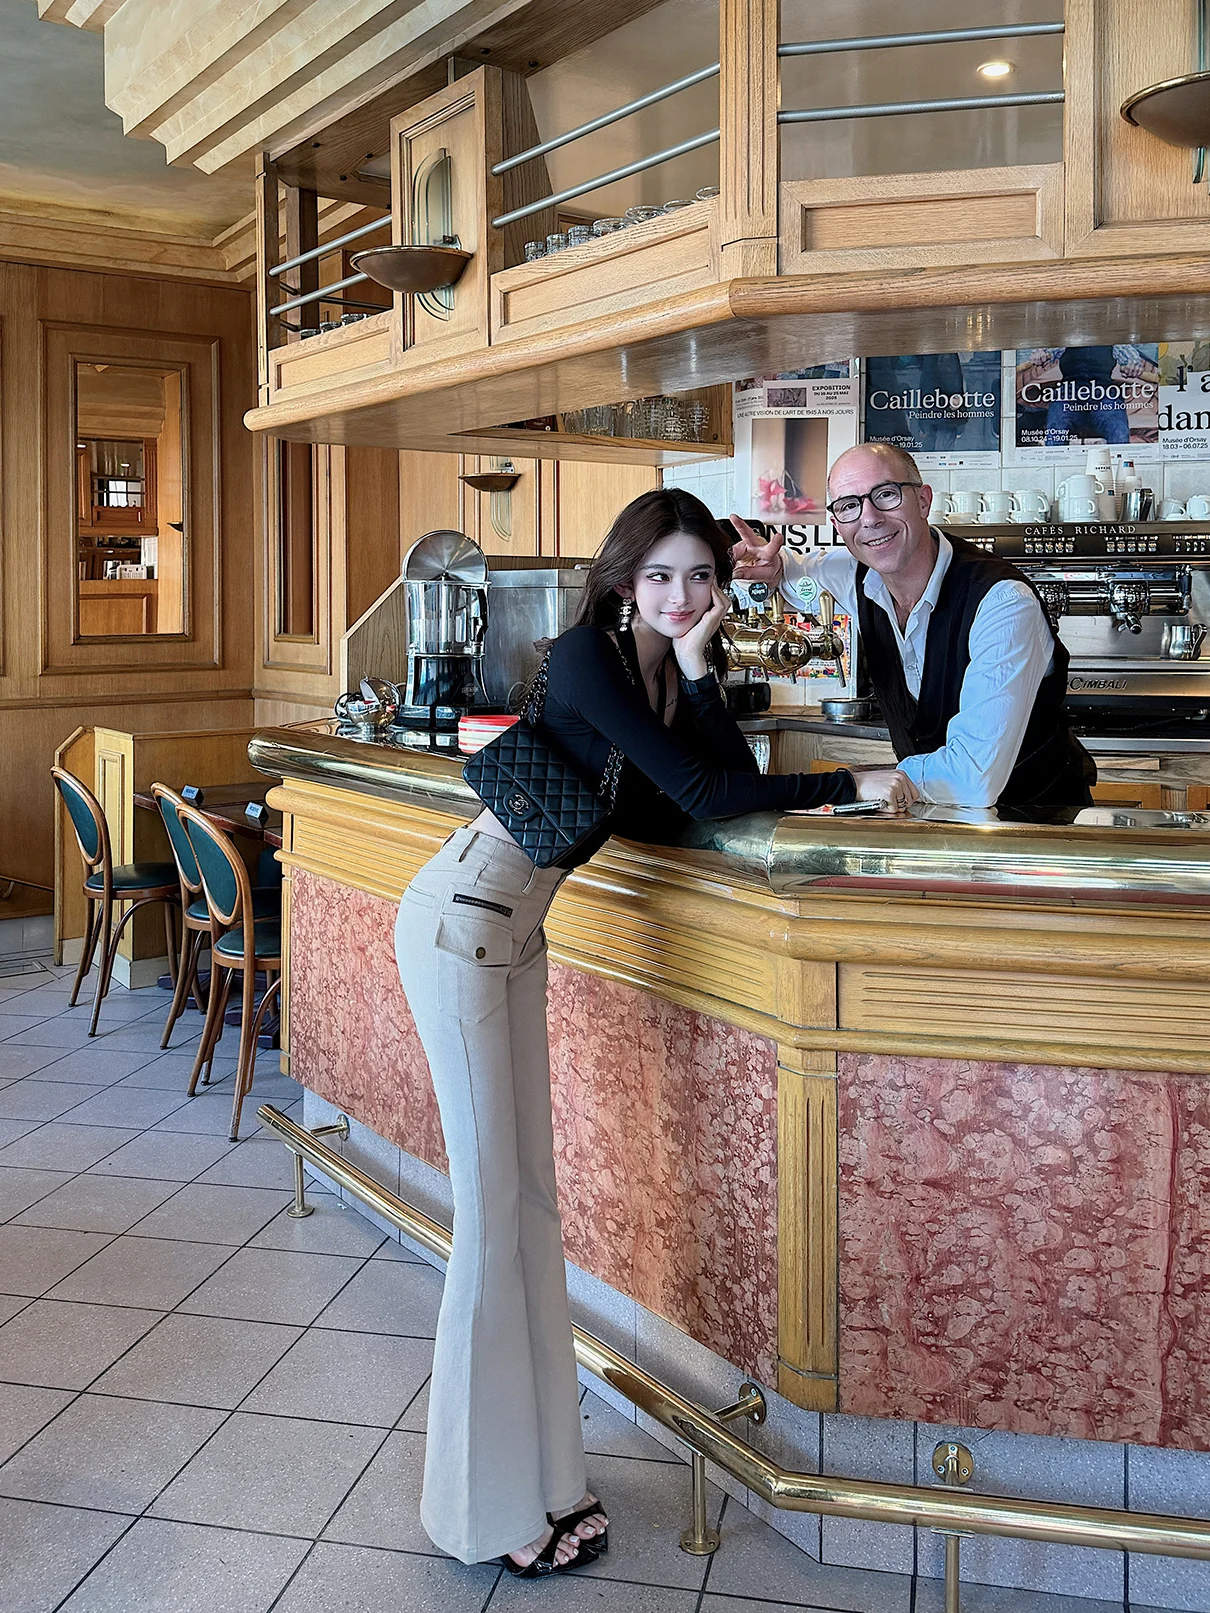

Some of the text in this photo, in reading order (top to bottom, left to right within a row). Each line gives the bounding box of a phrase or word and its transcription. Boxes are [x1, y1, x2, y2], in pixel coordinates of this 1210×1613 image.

[1021, 380, 1154, 403] Caillebotte
[870, 388, 995, 410] Caillebotte
[1063, 401, 1154, 411] Peindre les hommes
[909, 410, 995, 419] Peindre les hommes
[1044, 428, 1070, 436] d'Orsay
[1024, 524, 1136, 535] CAFÉS RICHARD
